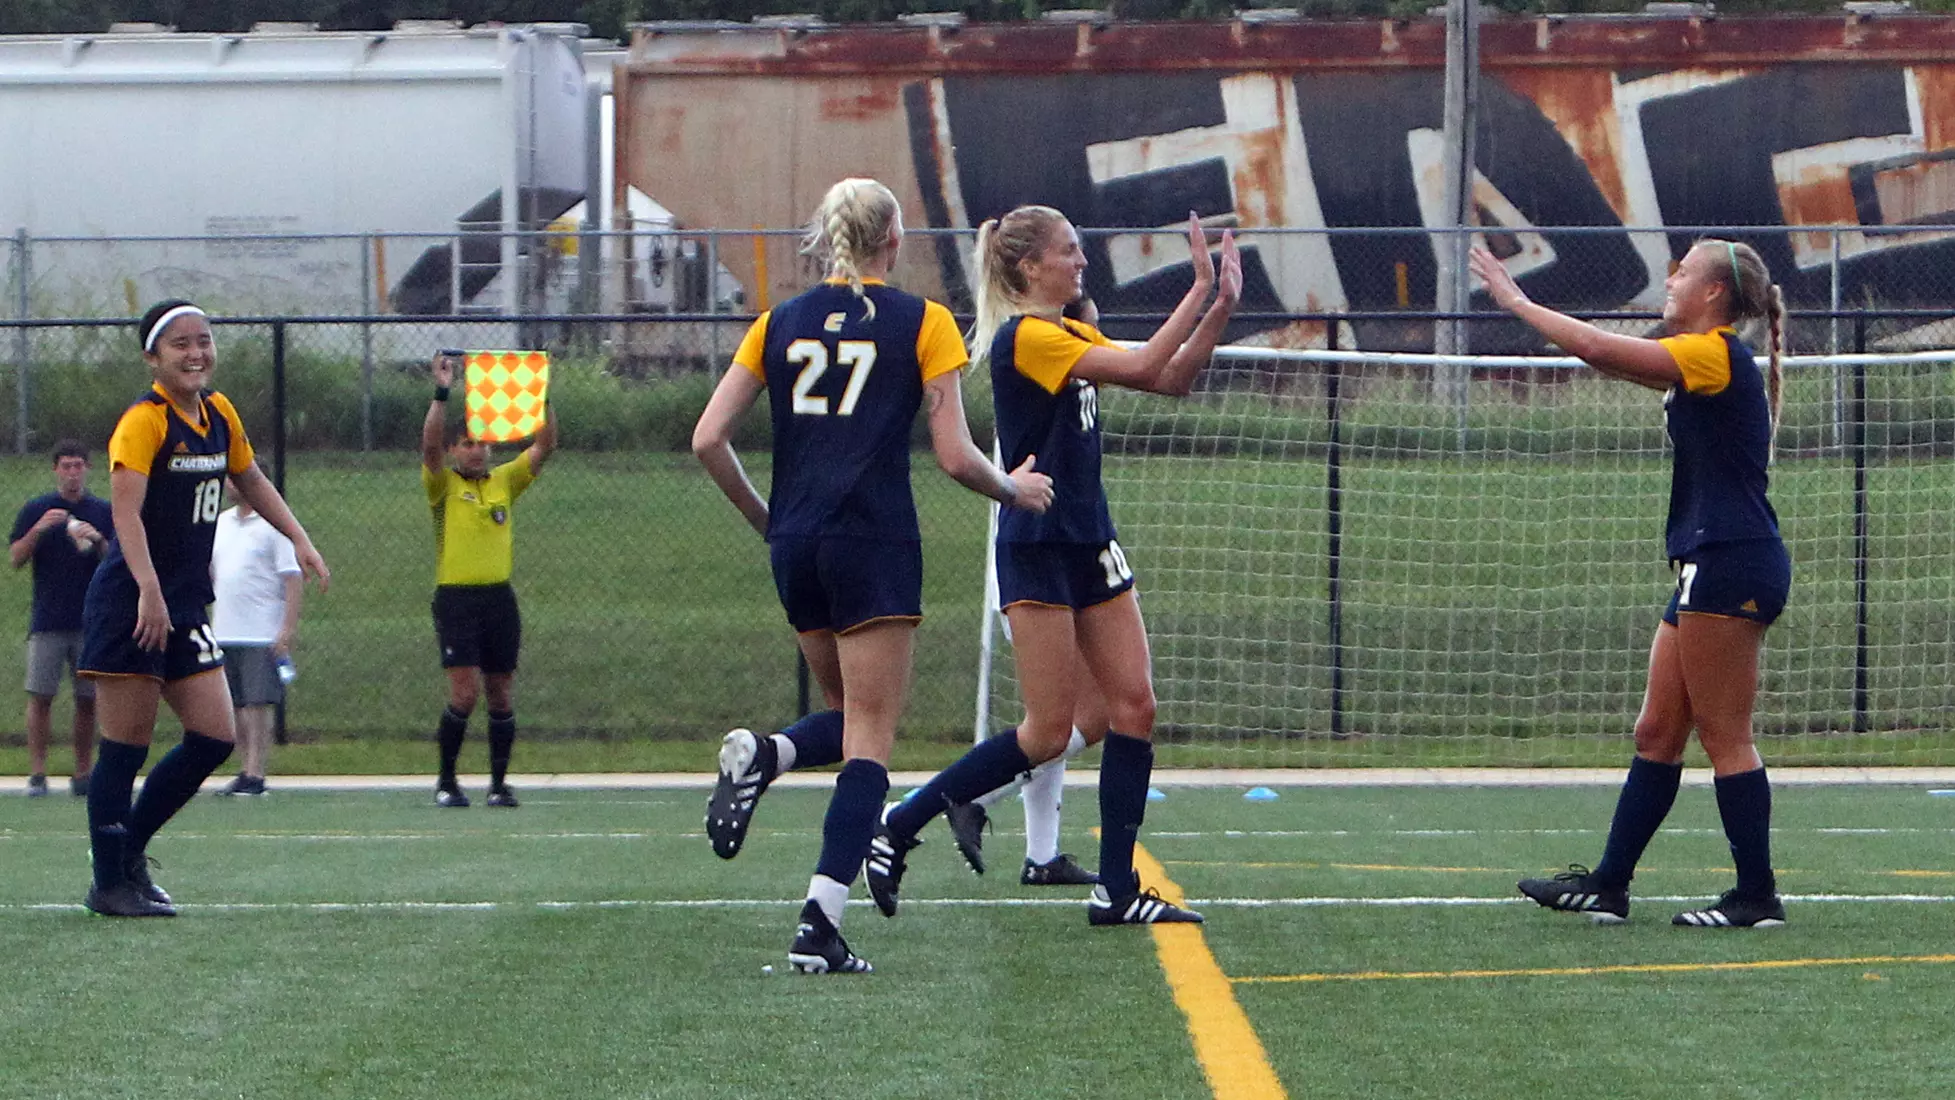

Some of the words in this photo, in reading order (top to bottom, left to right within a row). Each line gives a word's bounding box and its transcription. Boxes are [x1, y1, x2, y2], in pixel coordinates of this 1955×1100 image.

[786, 338, 878, 416] 27
[192, 478, 221, 524] 18
[1098, 539, 1133, 588] 10
